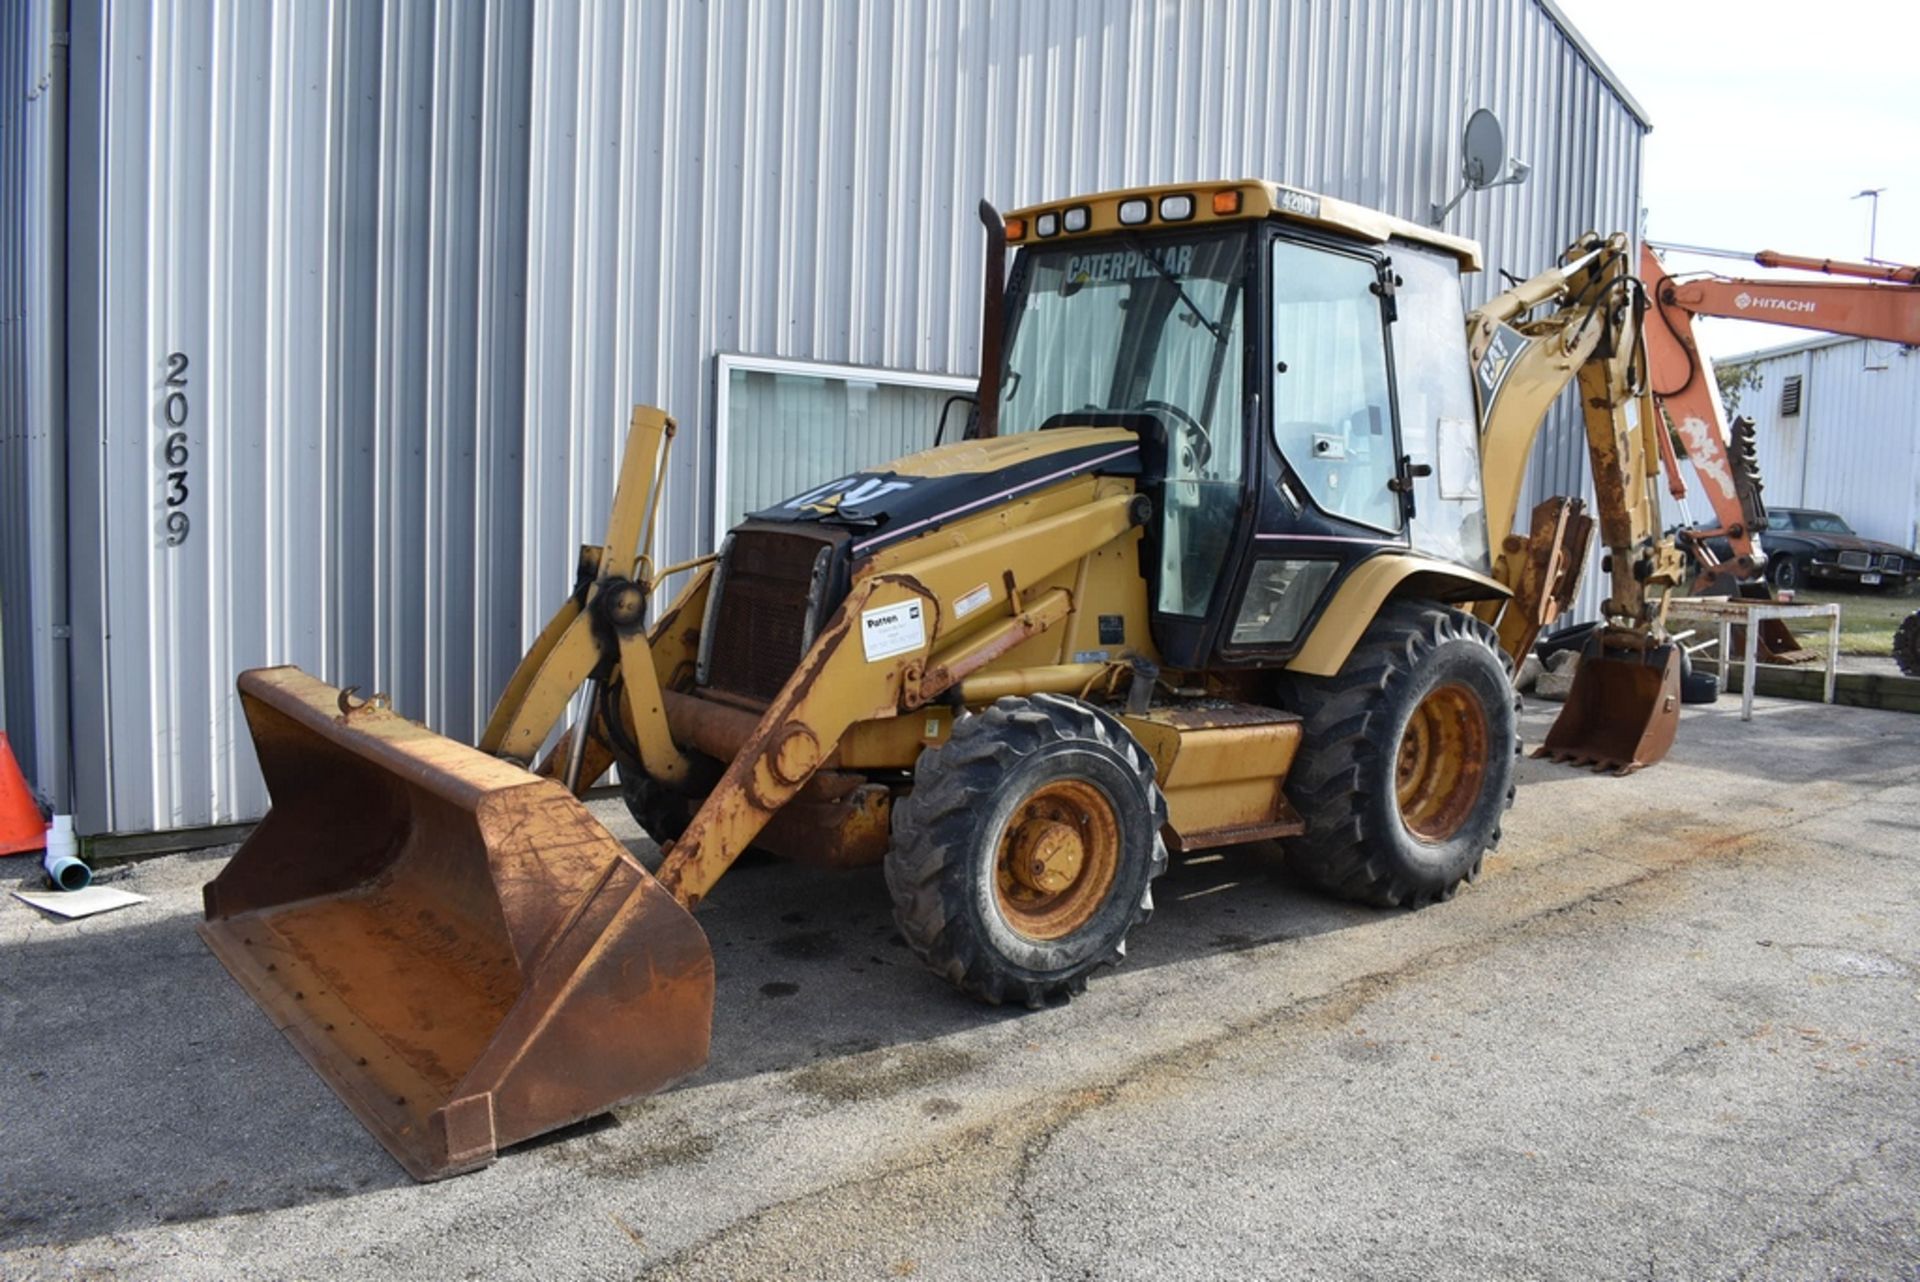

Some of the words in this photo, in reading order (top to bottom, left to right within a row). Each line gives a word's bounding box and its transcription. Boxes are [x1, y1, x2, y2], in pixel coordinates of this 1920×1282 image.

[1066, 245, 1192, 284] CATERPILLAR
[1752, 297, 1817, 313] HITACHI
[1480, 330, 1509, 390] CAT
[164, 352, 190, 547] 20639
